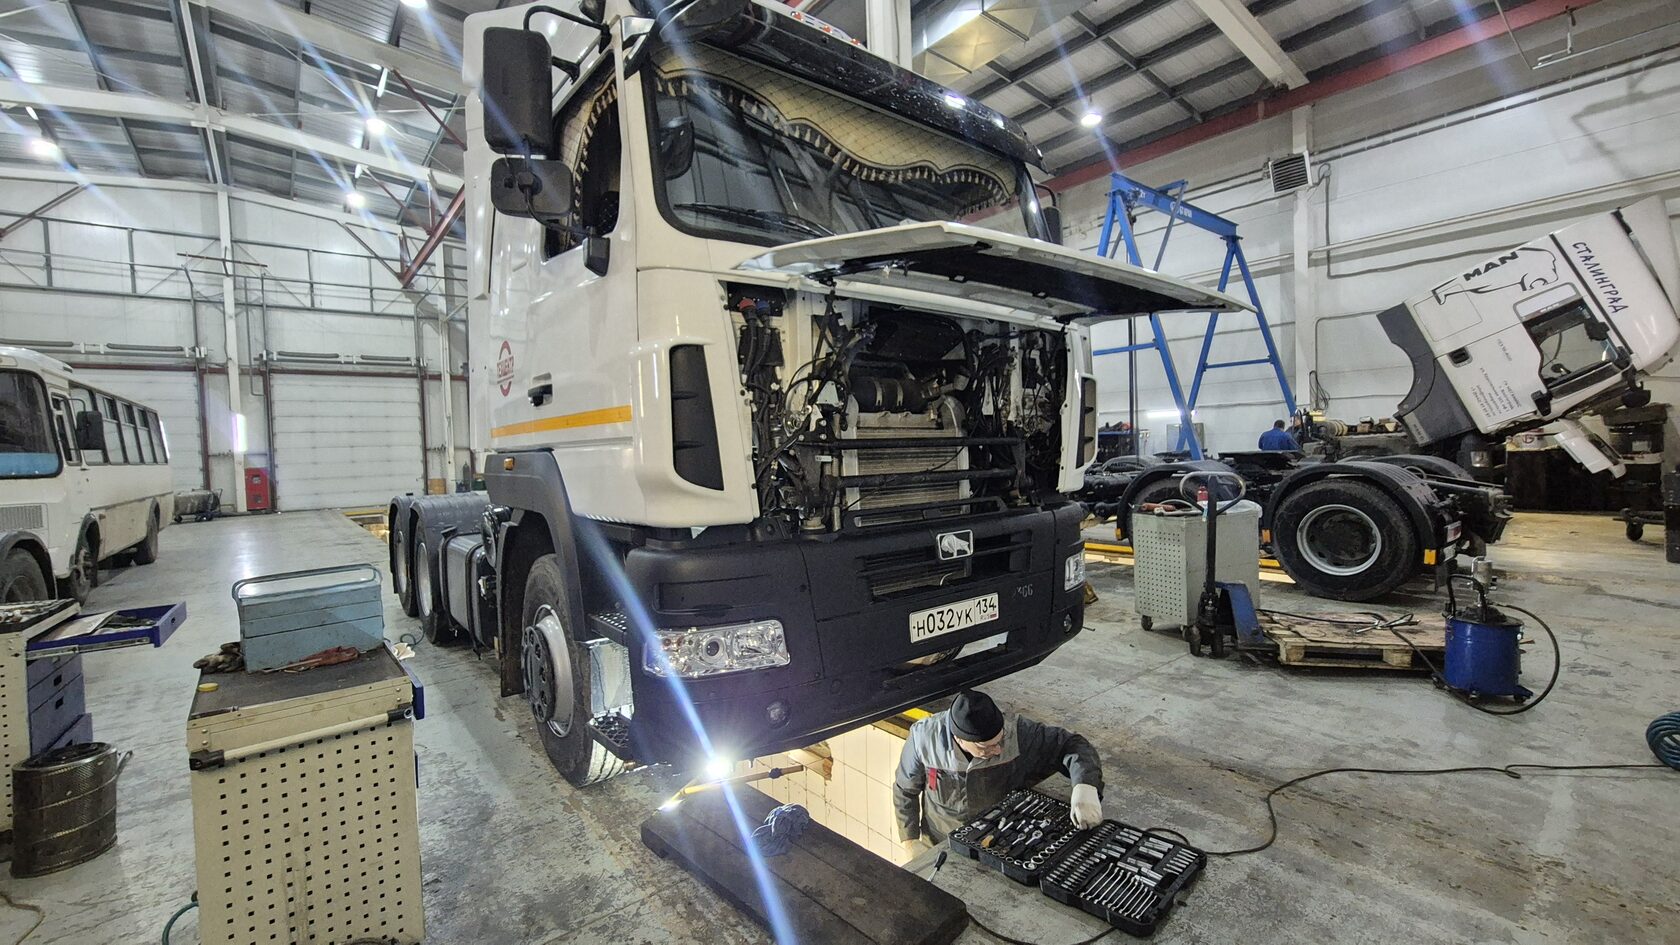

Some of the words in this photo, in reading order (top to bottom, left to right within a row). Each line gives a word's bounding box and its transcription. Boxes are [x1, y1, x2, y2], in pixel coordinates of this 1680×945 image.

[1463, 251, 1519, 282] MAN
[1572, 241, 1629, 314] СТАЛИНГРАД
[975, 597, 996, 615] 134
